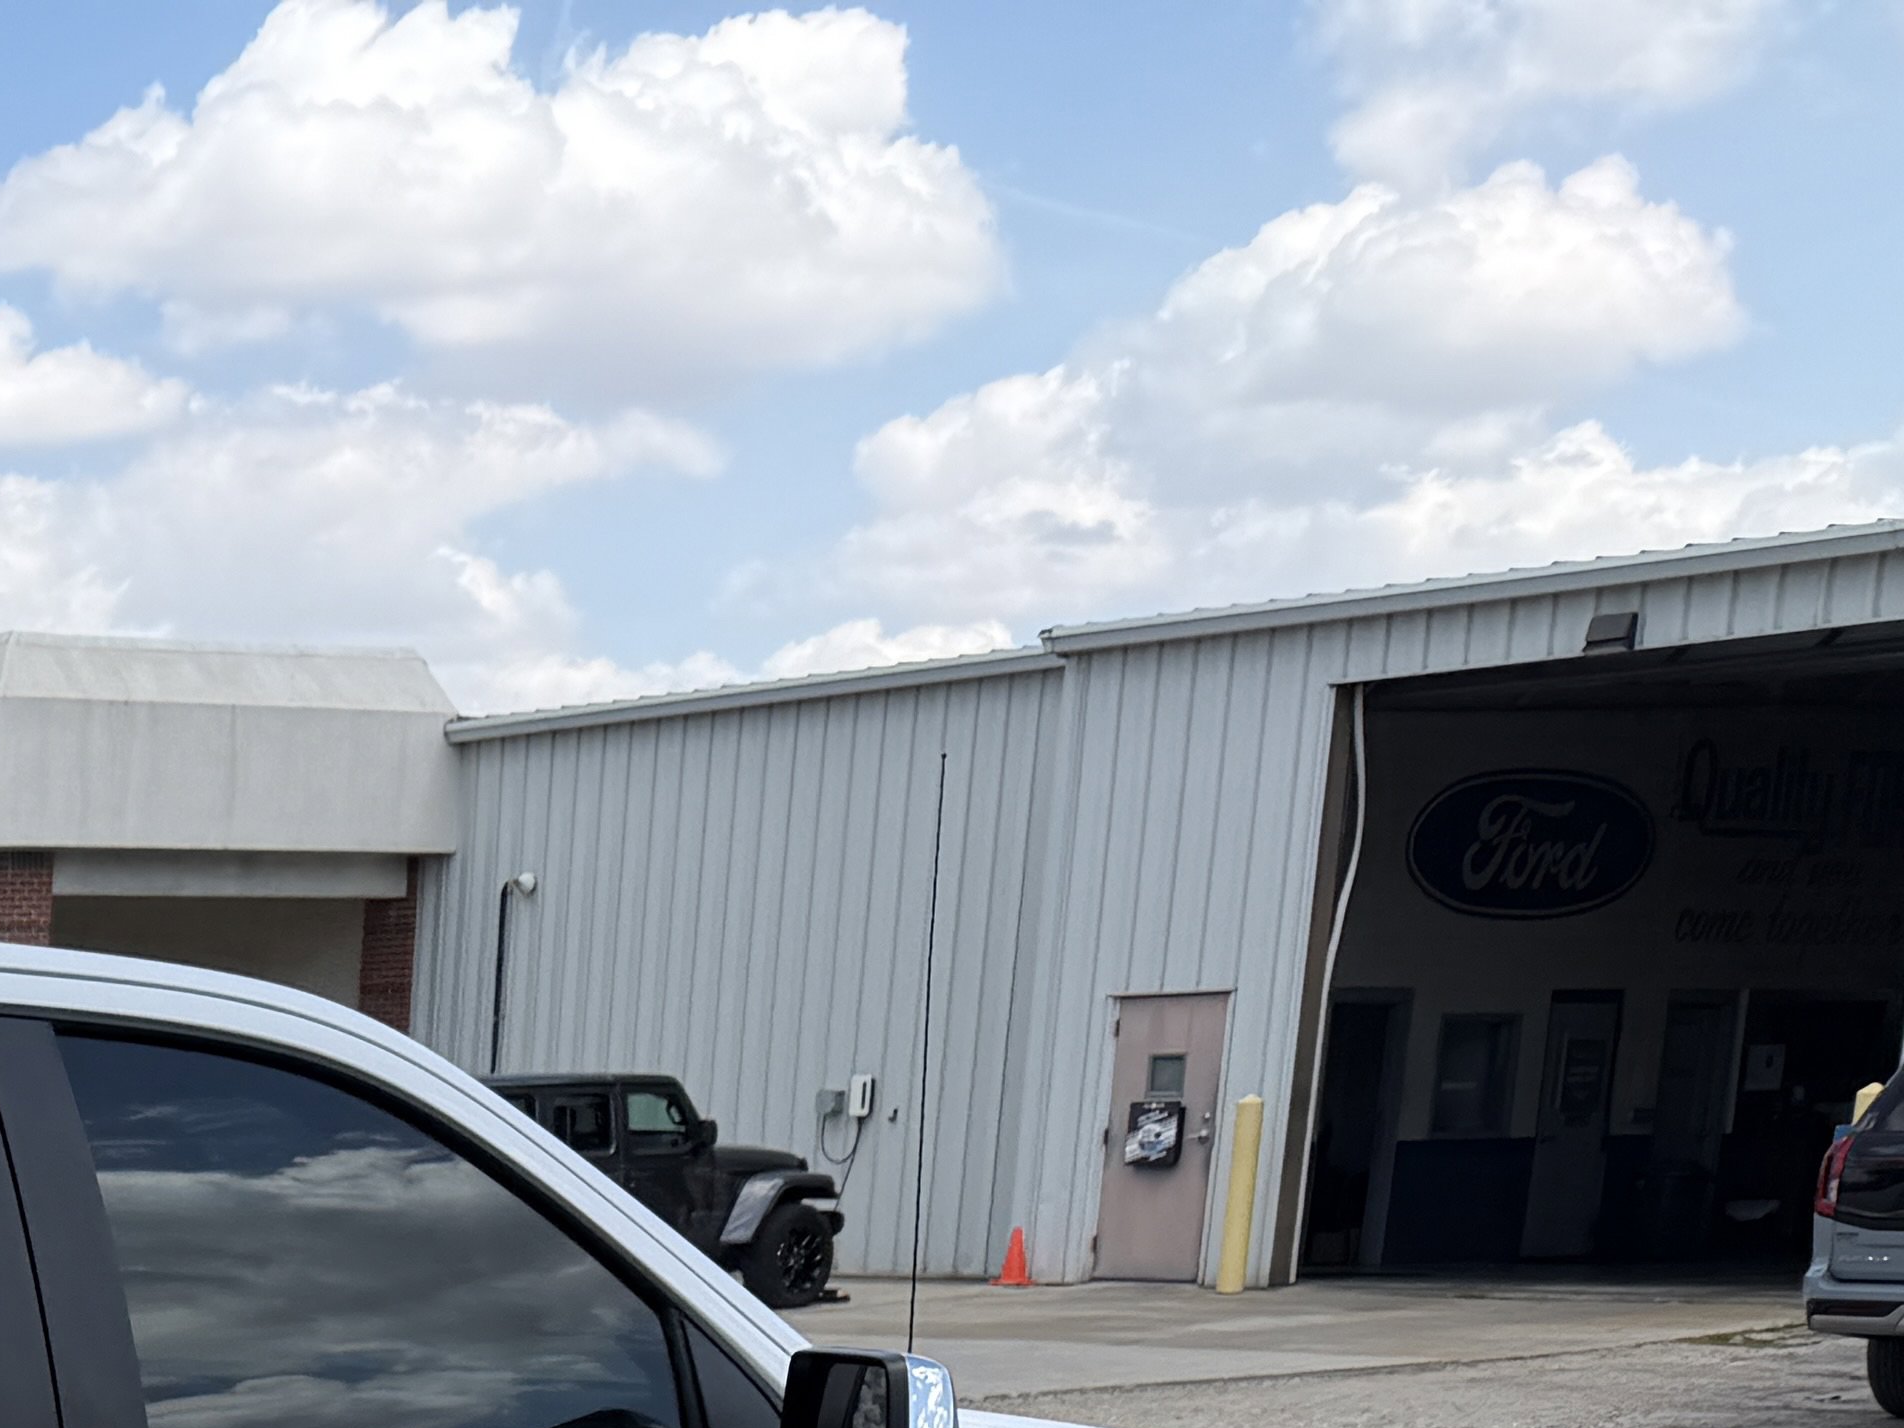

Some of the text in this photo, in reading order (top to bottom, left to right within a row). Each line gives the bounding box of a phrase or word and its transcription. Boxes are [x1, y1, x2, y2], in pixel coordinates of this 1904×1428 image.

[1461, 793, 1610, 892] Ford
[1670, 737, 1835, 856] Quality
[1674, 907, 1755, 944] come
